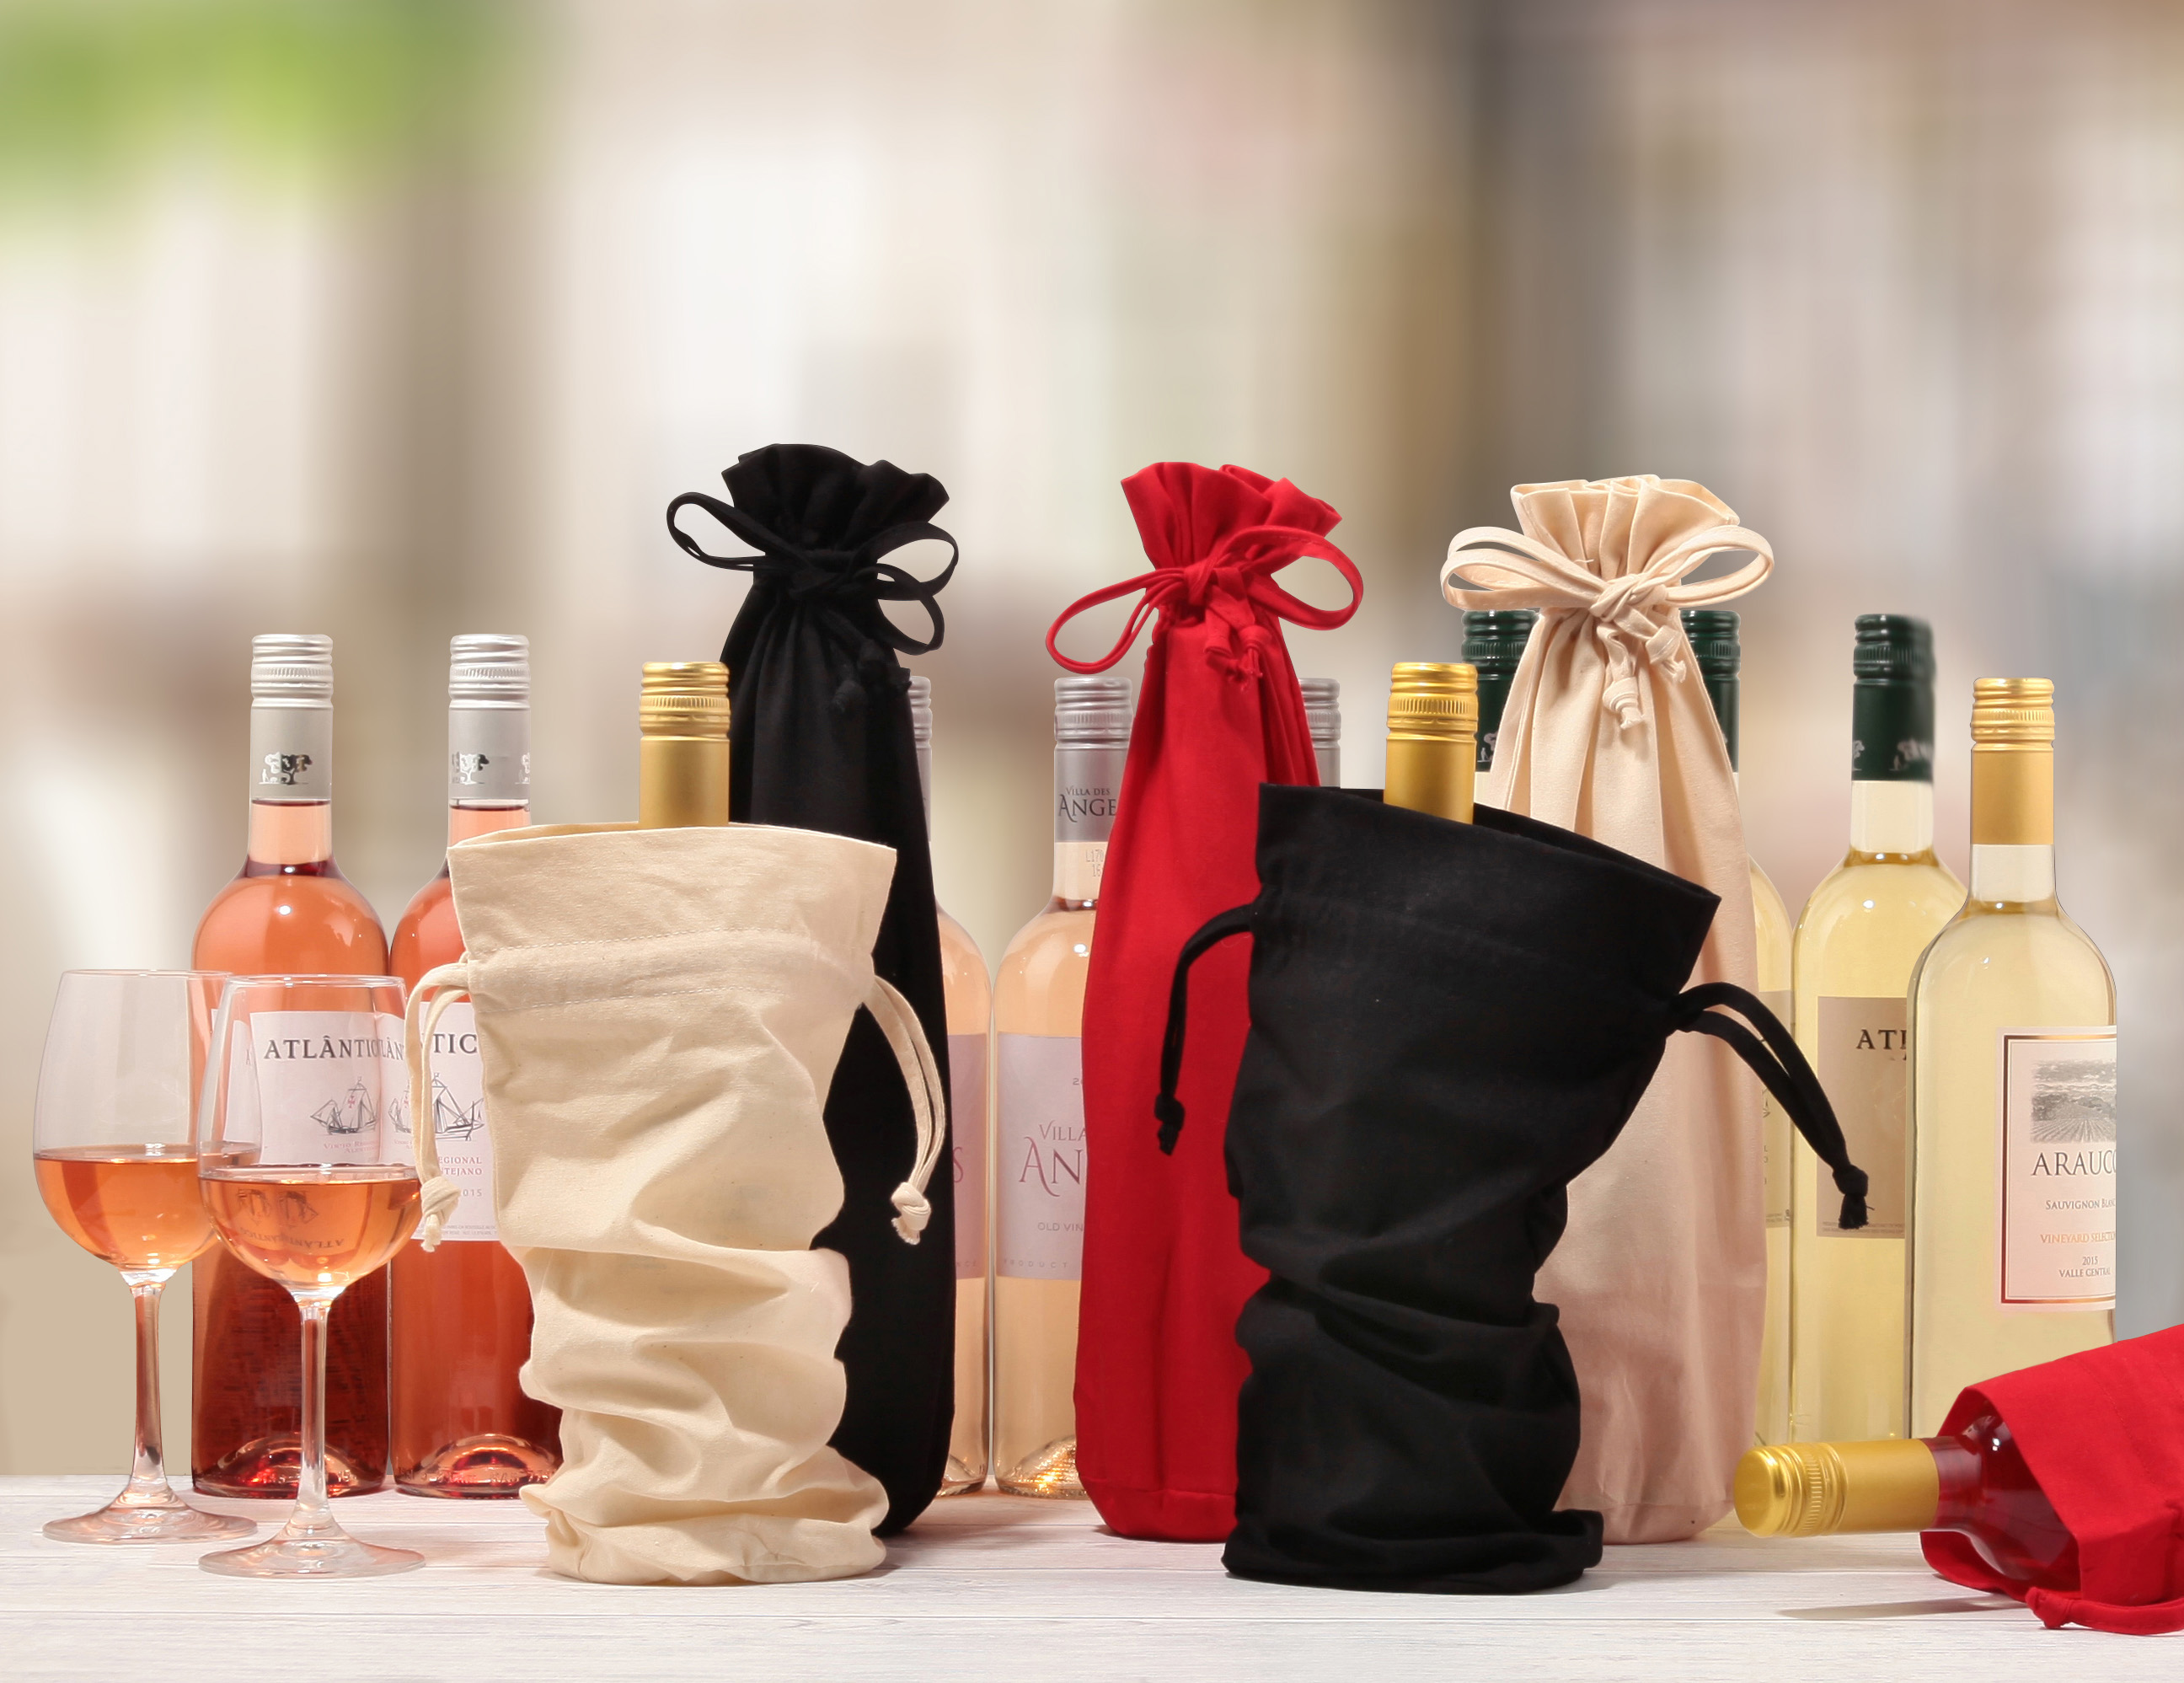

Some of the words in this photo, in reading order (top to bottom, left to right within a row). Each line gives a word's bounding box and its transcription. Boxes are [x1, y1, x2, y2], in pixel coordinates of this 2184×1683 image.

[1066, 785, 1090, 796] VILLA
[1093, 788, 1111, 796] DES
[1058, 794, 1117, 823] ANGE
[431, 1033, 478, 1054] TIC
[437, 1156, 483, 1165] EGIONAL
[443, 1167, 483, 1176] TEJANO
[1019, 1136, 1084, 1198] AN
[462, 1188, 483, 1197] 015
[2046, 1199, 2100, 1210] SAUVIGNON
[1037, 1222, 1060, 1231] OLD
[1063, 1223, 1084, 1232] VIN
[2040, 1233, 2090, 1243] VINEYARD
[2082, 1256, 2098, 1266] 2015
[2058, 1268, 2084, 1278] VALLE
